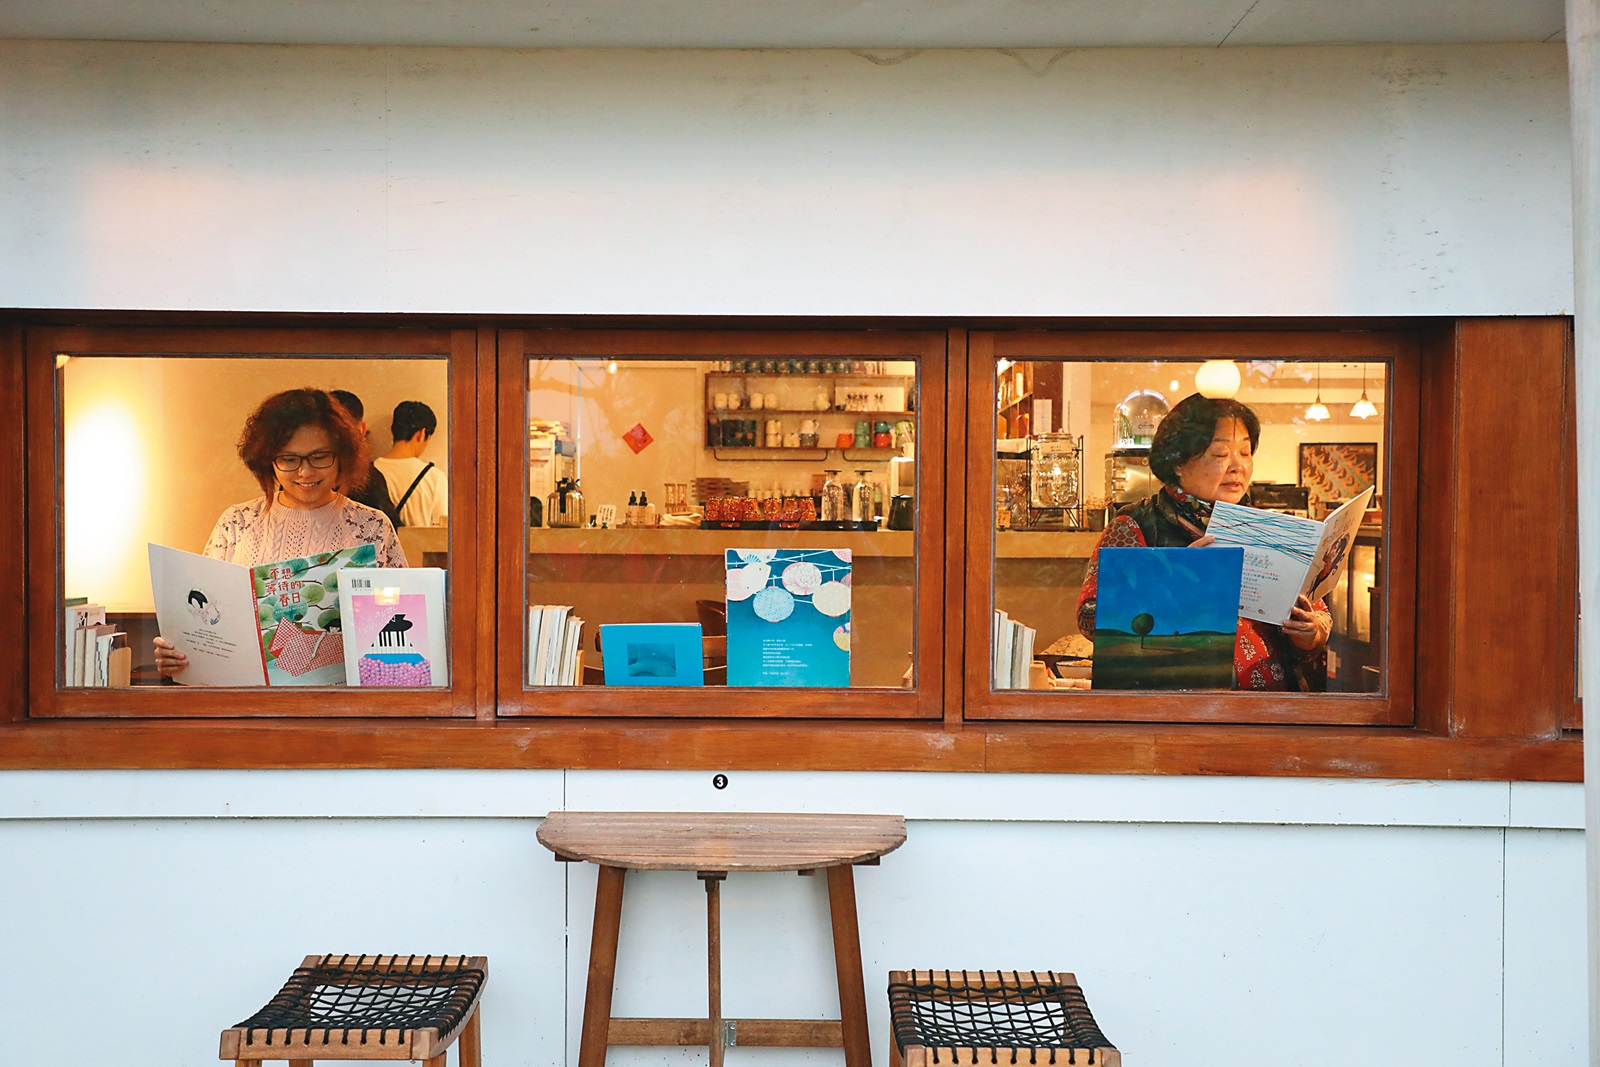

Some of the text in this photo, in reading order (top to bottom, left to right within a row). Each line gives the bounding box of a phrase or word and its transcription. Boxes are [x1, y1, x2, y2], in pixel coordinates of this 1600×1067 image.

[270, 567, 292, 580] 不想
[265, 580, 302, 595] 等待的
[279, 592, 300, 607] 春日
